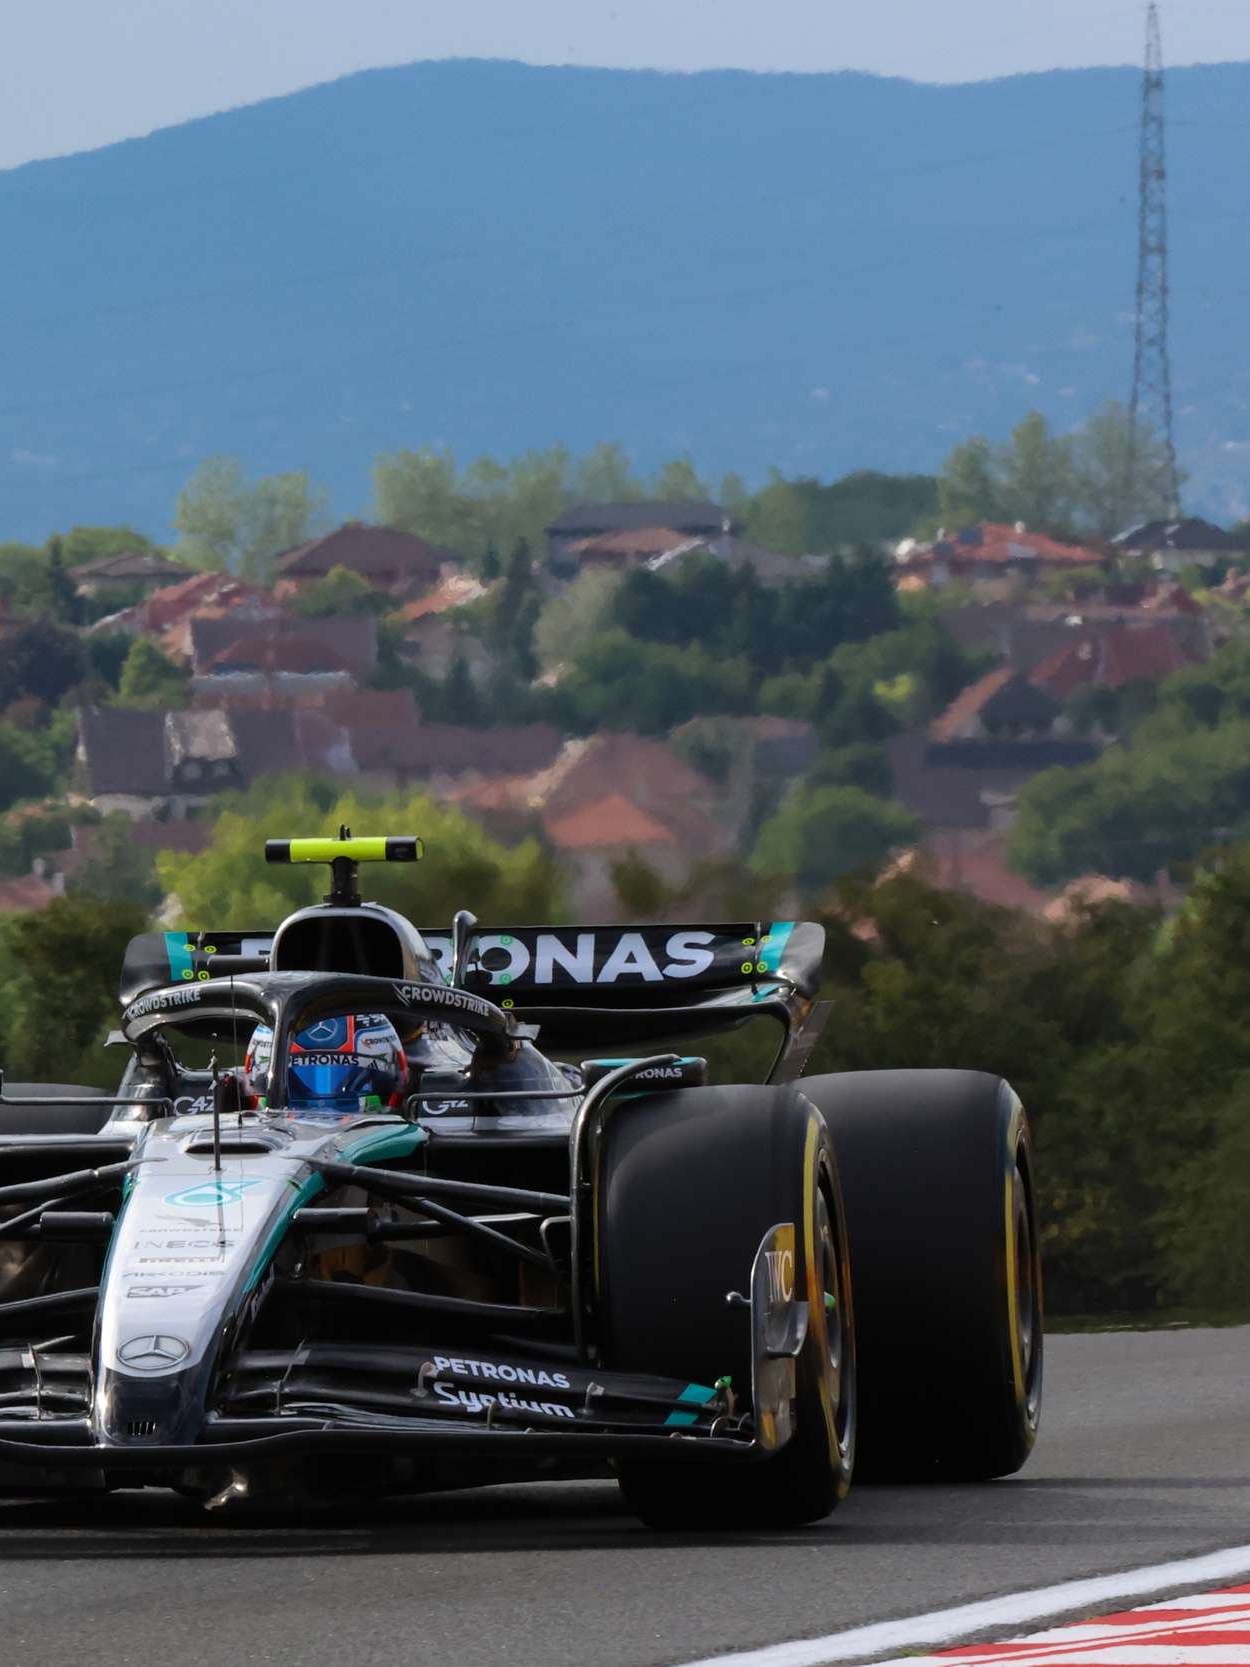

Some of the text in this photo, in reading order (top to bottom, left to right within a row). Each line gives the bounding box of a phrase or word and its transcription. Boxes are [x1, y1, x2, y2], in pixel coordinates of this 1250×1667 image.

[241, 931, 716, 985] RONAS
[129, 988, 201, 1018] CROWDSTRIKE
[401, 985, 490, 1017] CROWDSTRIKE
[289, 1055, 359, 1067] ETRONAS
[134, 1240, 235, 1249] INEOS
[128, 1286, 188, 1297] SAP
[764, 1250, 792, 1302] IWC
[434, 1356, 571, 1389] PETRONAS
